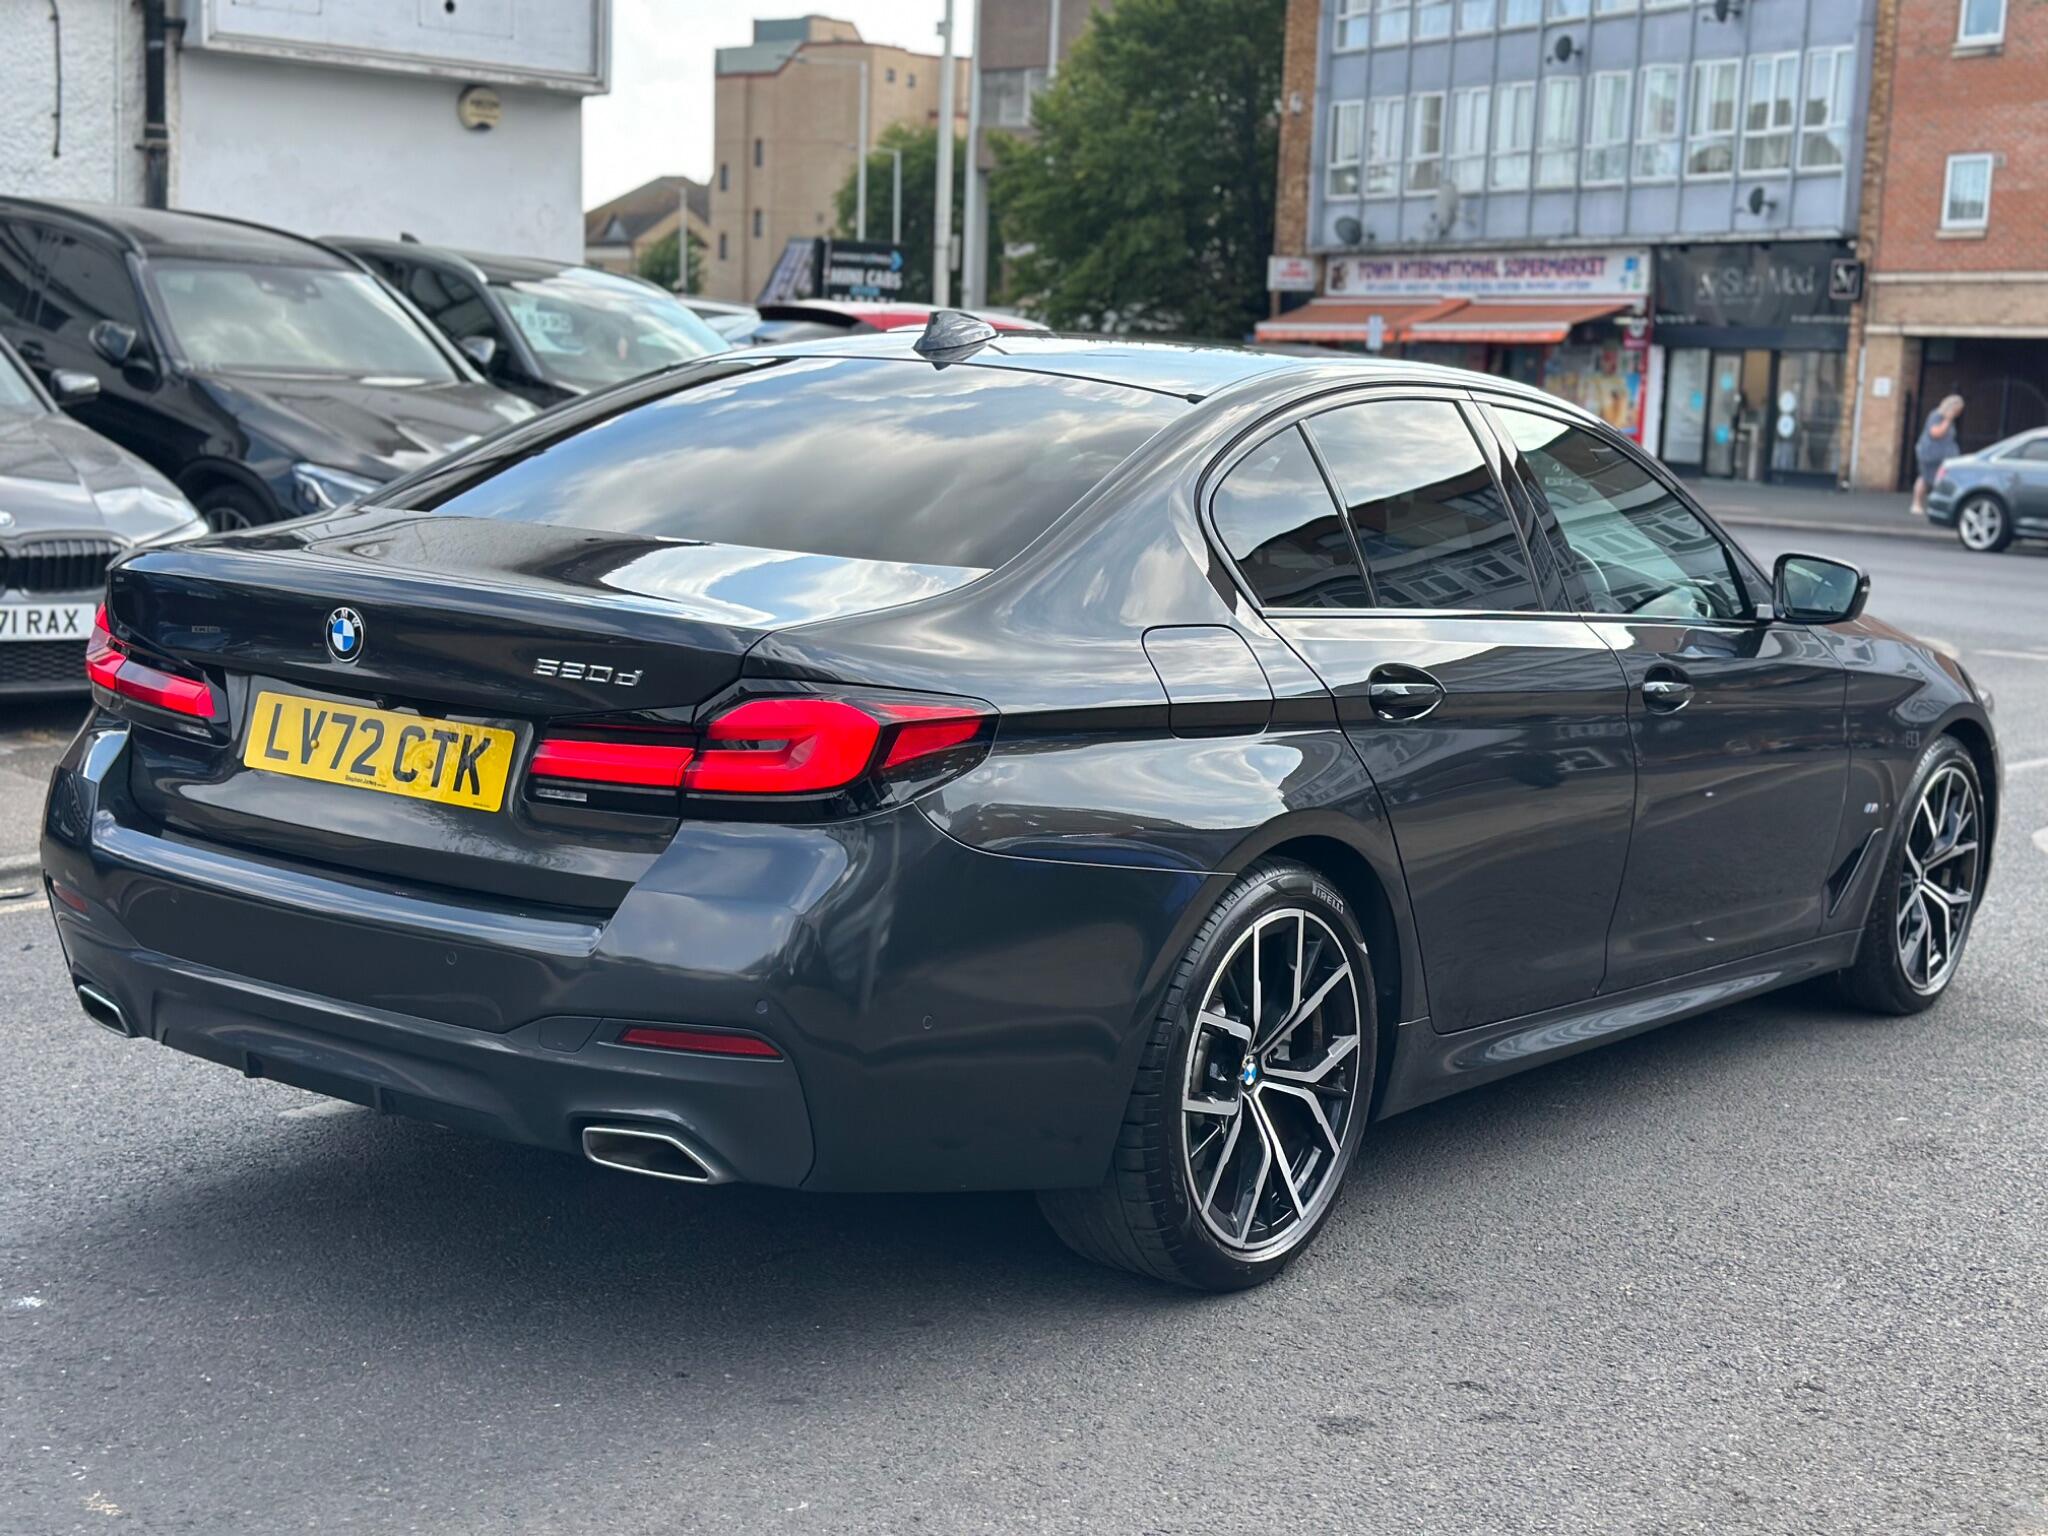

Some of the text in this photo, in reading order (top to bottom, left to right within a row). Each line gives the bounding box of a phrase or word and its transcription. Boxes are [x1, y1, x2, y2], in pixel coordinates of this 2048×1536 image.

[27, 609, 78, 633] RAX
[264, 703, 491, 796] LV72 CTK
[1312, 880, 1344, 915] PIRELLI
